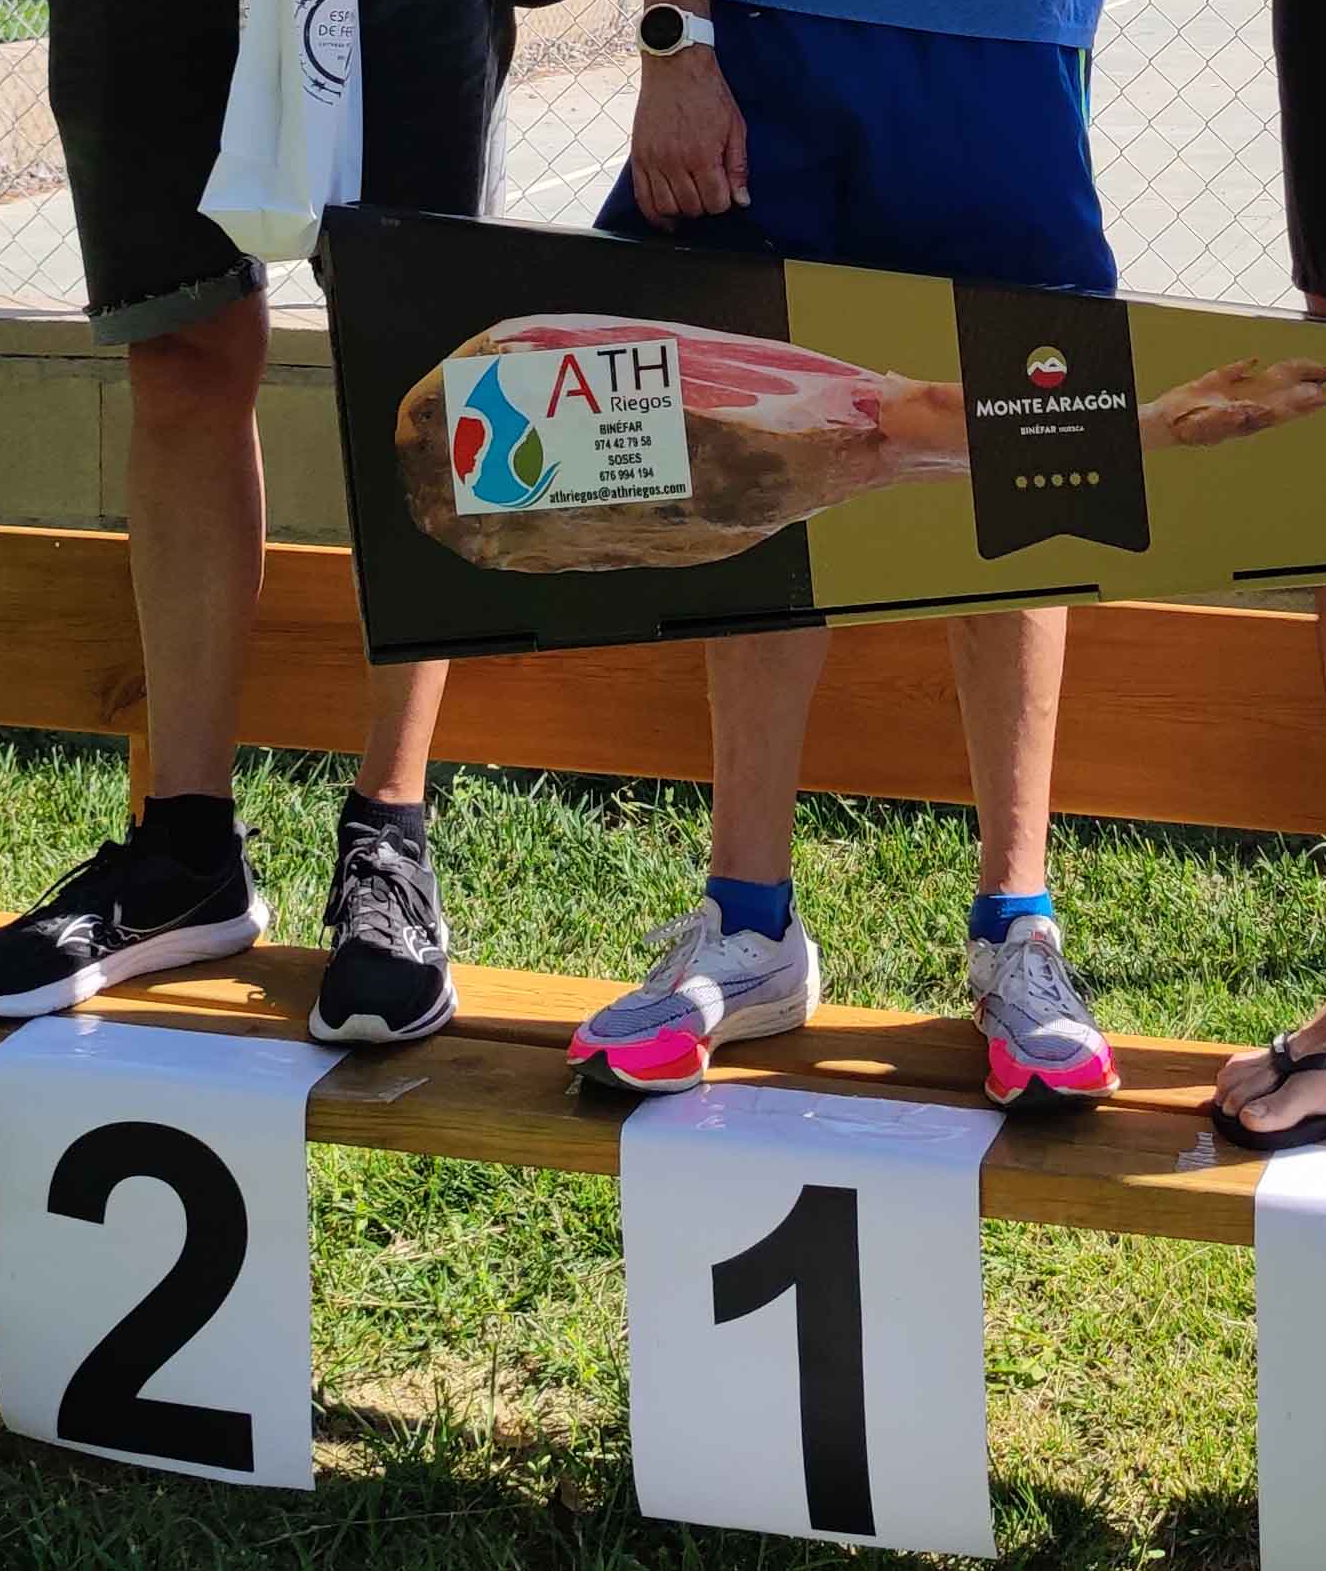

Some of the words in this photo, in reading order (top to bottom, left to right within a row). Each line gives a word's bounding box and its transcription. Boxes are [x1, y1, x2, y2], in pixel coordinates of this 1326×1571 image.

[318, 24, 337, 37] DE
[546, 344, 671, 419] ATH
[610, 393, 673, 415] Riegos
[975, 396, 1044, 418] MONTE
[1044, 389, 1128, 414] ARAGÓN
[599, 420, 643, 435] BINÉFAR
[594, 439, 611, 450] 974
[613, 438, 625, 449] 42
[607, 453, 643, 466] SOSES
[638, 467, 654, 479] 194
[549, 483, 687, 504] athriegos@athriegos.com
[45, 1118, 256, 1473] 2
[710, 1182, 878, 1537] 1
